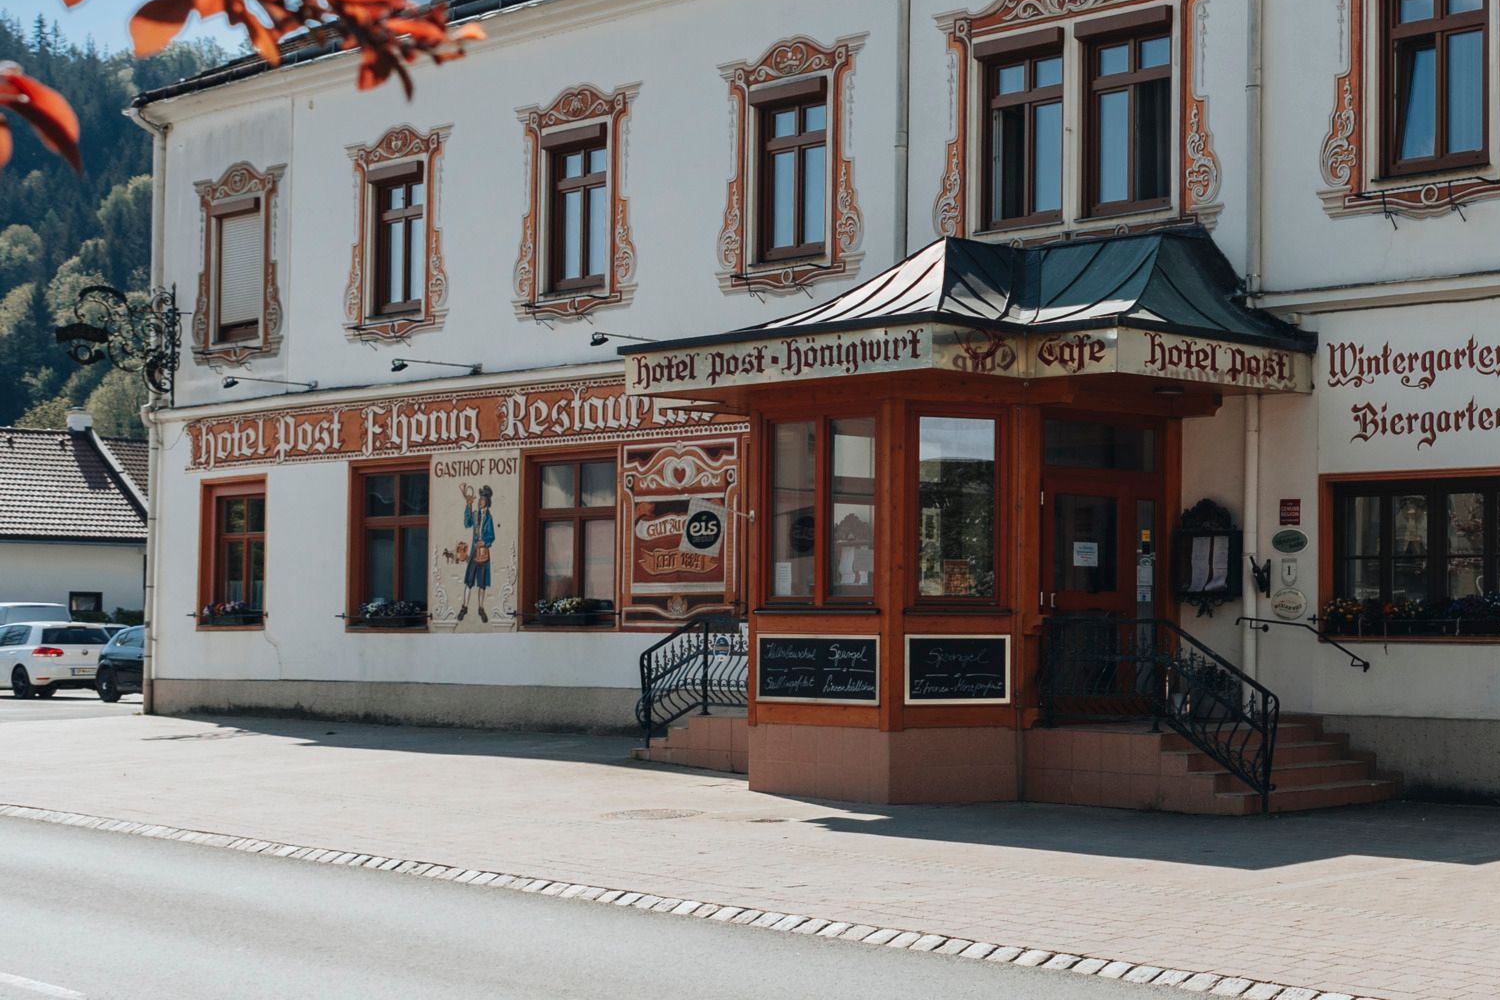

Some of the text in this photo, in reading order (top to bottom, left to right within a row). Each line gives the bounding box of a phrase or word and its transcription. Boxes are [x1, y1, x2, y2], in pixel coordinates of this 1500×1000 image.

[1037, 333, 1107, 373] Cafe
[434, 457, 518, 478] GASTHOF POST
[647, 519, 668, 538] GUT
[689, 515, 718, 537] eis
